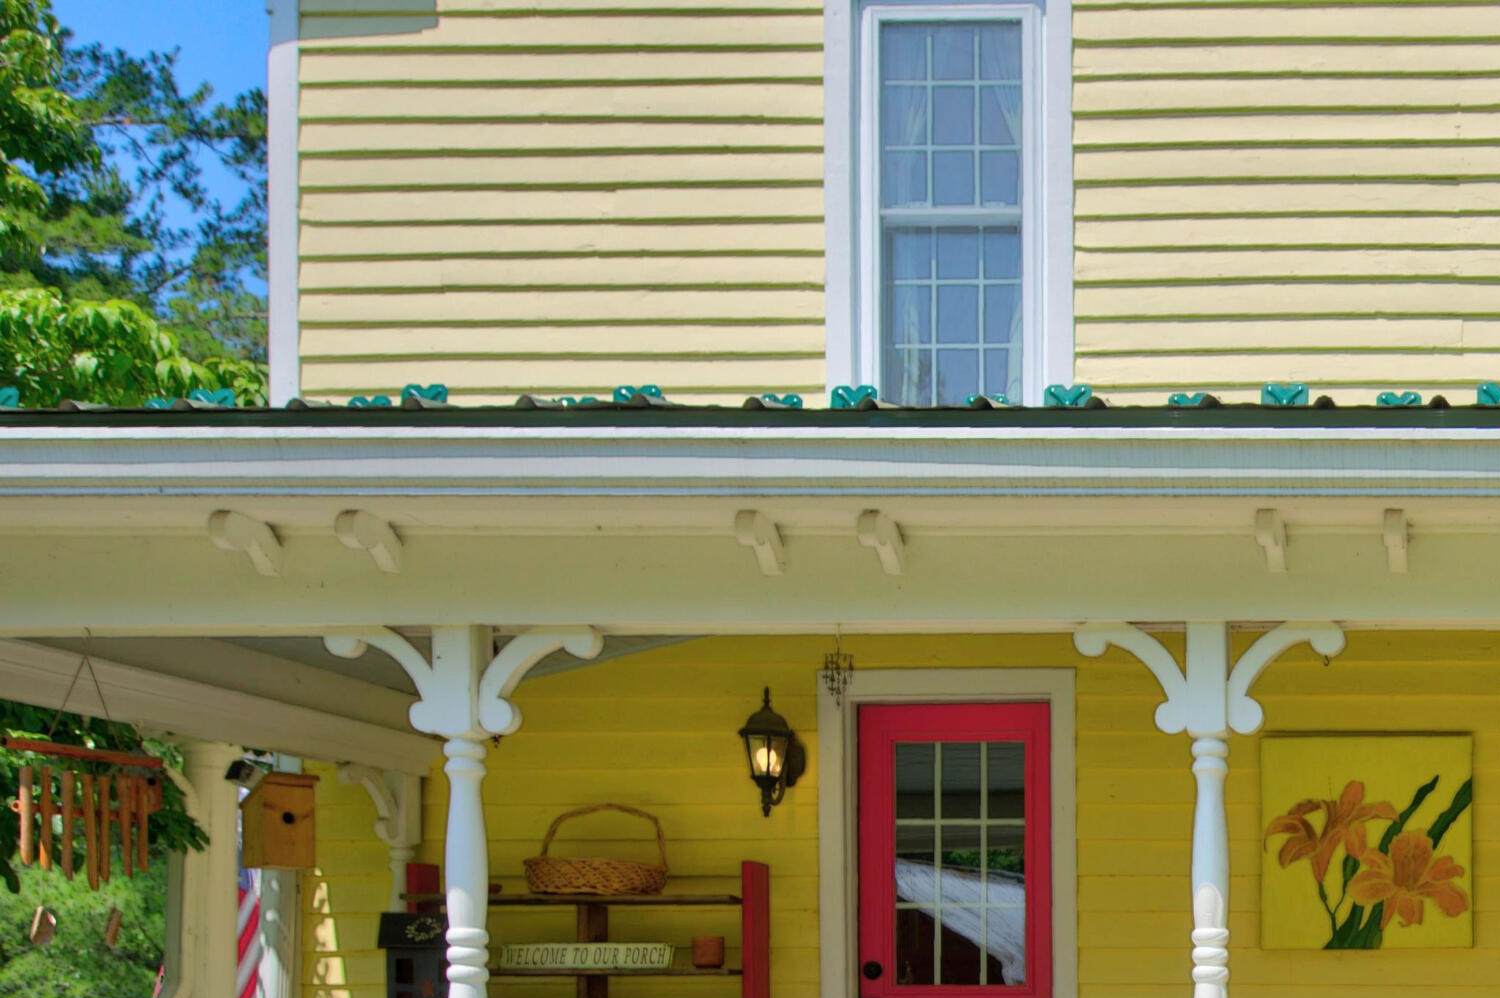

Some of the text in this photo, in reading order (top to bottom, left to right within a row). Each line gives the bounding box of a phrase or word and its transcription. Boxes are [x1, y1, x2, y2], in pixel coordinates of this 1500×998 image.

[505, 946, 666, 966] WELCOME TO OUR PORCH
